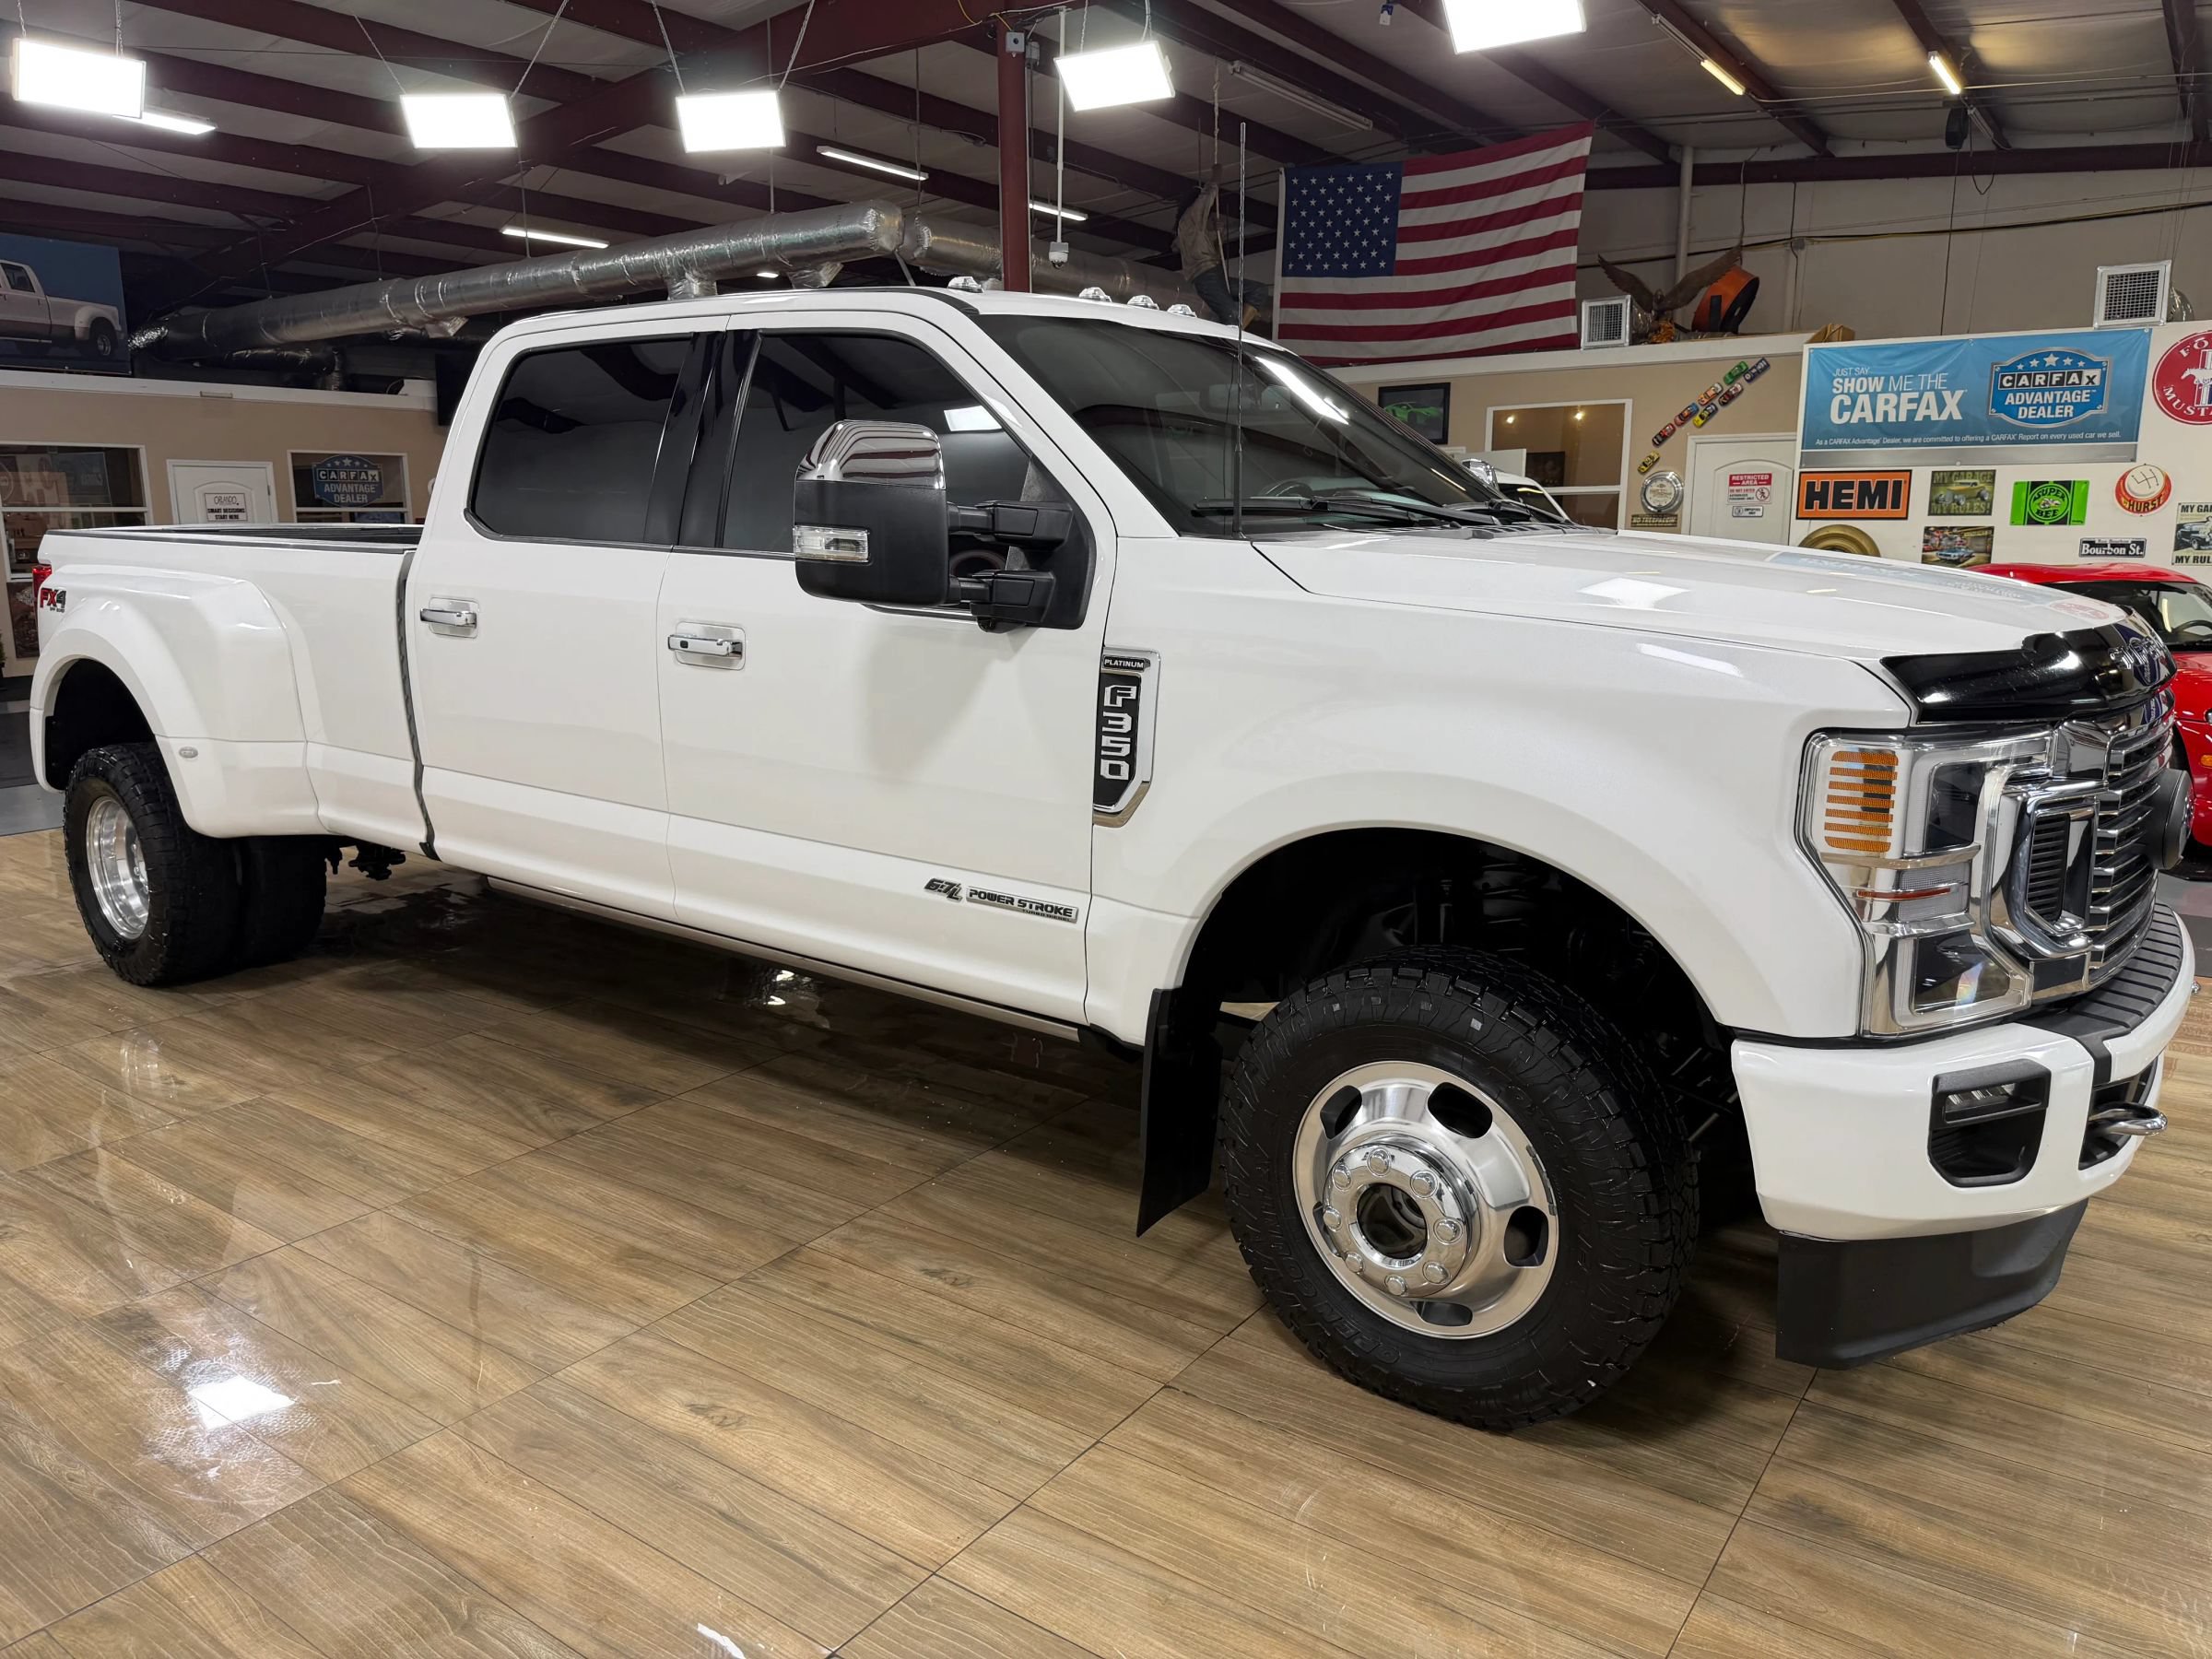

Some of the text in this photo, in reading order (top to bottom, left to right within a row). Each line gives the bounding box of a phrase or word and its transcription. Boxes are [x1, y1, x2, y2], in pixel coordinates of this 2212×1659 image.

[2179, 336, 2212, 358] FO
[1832, 367, 1870, 377] JUST SAY
[1832, 372, 1948, 394] SHOW ME THE
[2001, 372, 2098, 387] CARFAX
[1830, 389, 1965, 425] CARFAX
[2162, 384, 2212, 417] MUST
[2018, 405, 2074, 418] DEALER
[1961, 434, 1984, 442] offering
[2018, 433, 2040, 441] Report
[2067, 431, 2084, 440] used
[2108, 430, 2122, 439] sell.
[319, 470, 377, 481] CARFAX
[334, 494, 369, 503] DEALER
[1804, 478, 1905, 512] HEMI
[2032, 487, 2065, 501] SUPER
[2127, 493, 2163, 512] HURST
[2180, 504, 2194, 513] MY
[2036, 509, 2059, 519] BEE
[2081, 543, 2144, 555] Bourbon St.
[2174, 555, 2190, 564] MY
[40, 586, 67, 609] FX4
[1104, 659, 1144, 668] PLATINUM
[1100, 685, 1137, 781] F350
[969, 888, 1014, 906] POWER
[1017, 898, 1073, 918] STROKE
